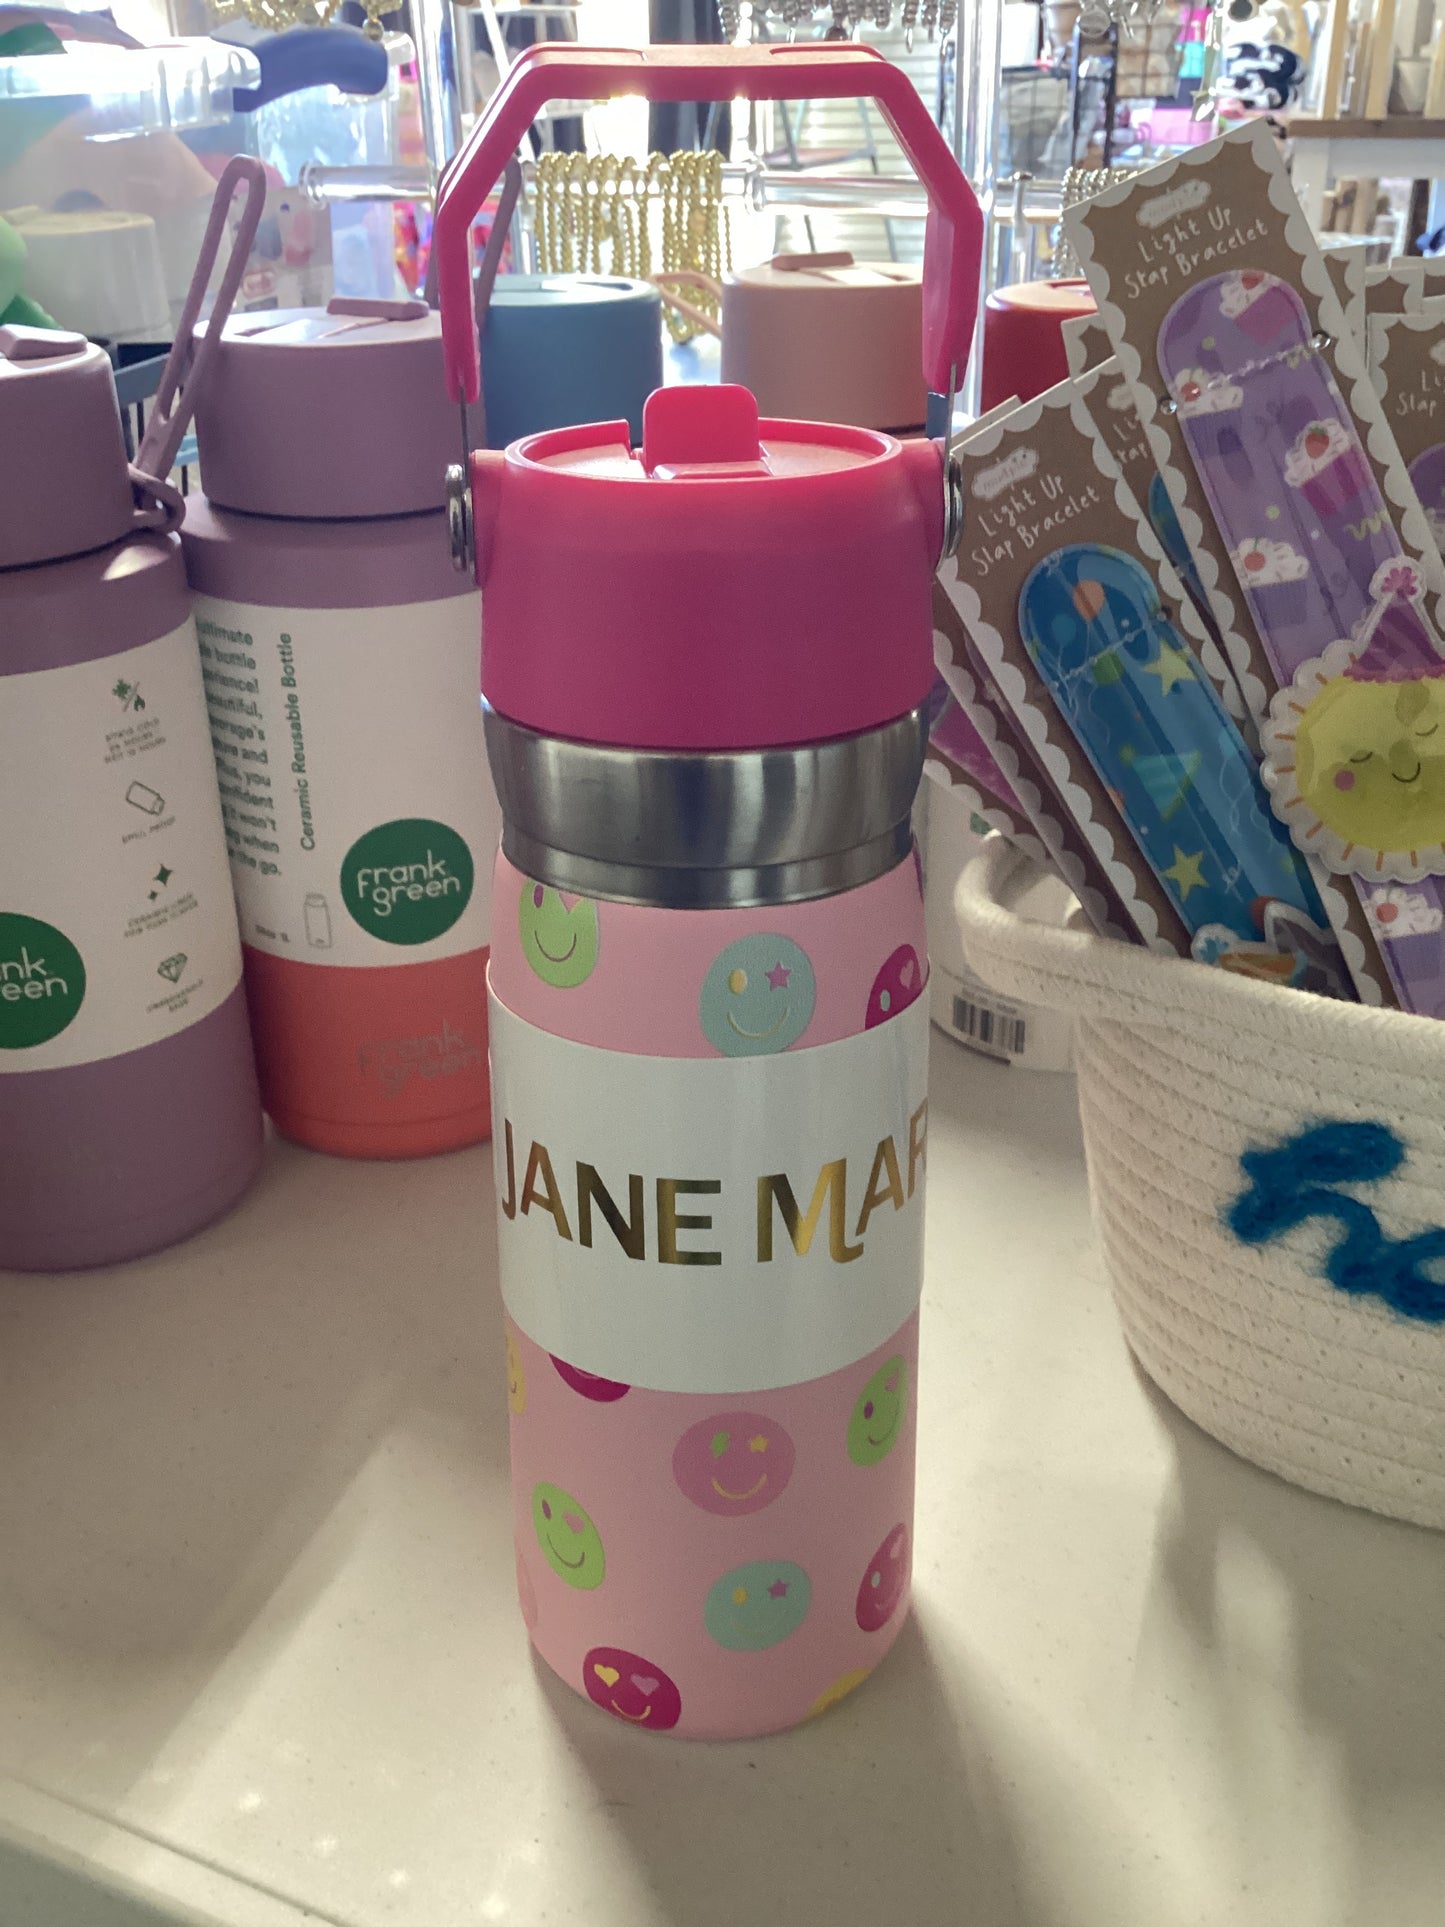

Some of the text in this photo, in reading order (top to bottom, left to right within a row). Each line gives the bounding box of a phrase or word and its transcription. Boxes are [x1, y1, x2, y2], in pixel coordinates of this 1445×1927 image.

[1138, 205, 1231, 263] Light Up
[1174, 218, 1269, 277] Bracelet
[971, 485, 1100, 576] Slap Bracelet
[977, 488, 1037, 537] Light
[1039, 473, 1064, 500] Up
[276, 632, 316, 851] Ceramic Reusable Bottle
[357, 849, 447, 898] frank
[372, 876, 461, 917] green
[0, 946, 48, 981] nk
[0, 977, 68, 1002] een
[501, 1116, 723, 1266] JANE
